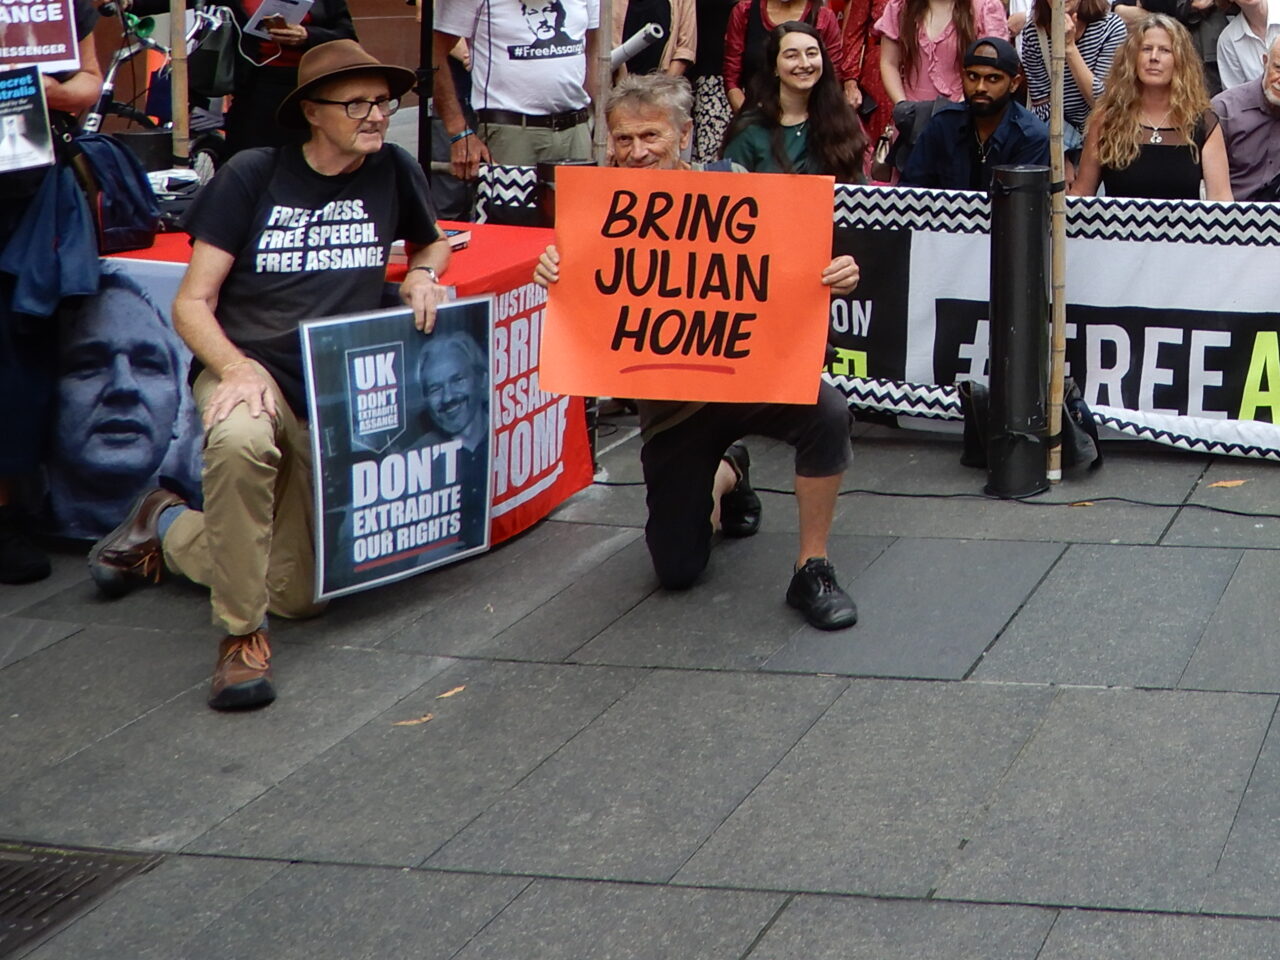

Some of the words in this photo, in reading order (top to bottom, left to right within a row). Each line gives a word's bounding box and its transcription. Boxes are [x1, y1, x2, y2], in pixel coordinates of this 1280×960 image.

[0, 86, 36, 101] tralia
[258, 227, 306, 250] FREE
[307, 222, 379, 247] SPEECH.
[266, 205, 312, 228] FREE
[601, 190, 759, 244] BRING
[255, 251, 304, 273] FREE
[305, 246, 385, 271] ASSANGE
[595, 247, 770, 302] JULIAN
[494, 308, 547, 385] BRI
[611, 305, 757, 359] HOME
[353, 351, 397, 391] UK
[357, 388, 398, 411] DON'T
[358, 404, 398, 421] EXTRADITE
[359, 414, 399, 431] ASSANGE
[352, 439, 463, 509] DON'T
[352, 484, 462, 538] EXTRADITE
[353, 531, 394, 564] OUR
[396, 511, 462, 551] RIGHTS
